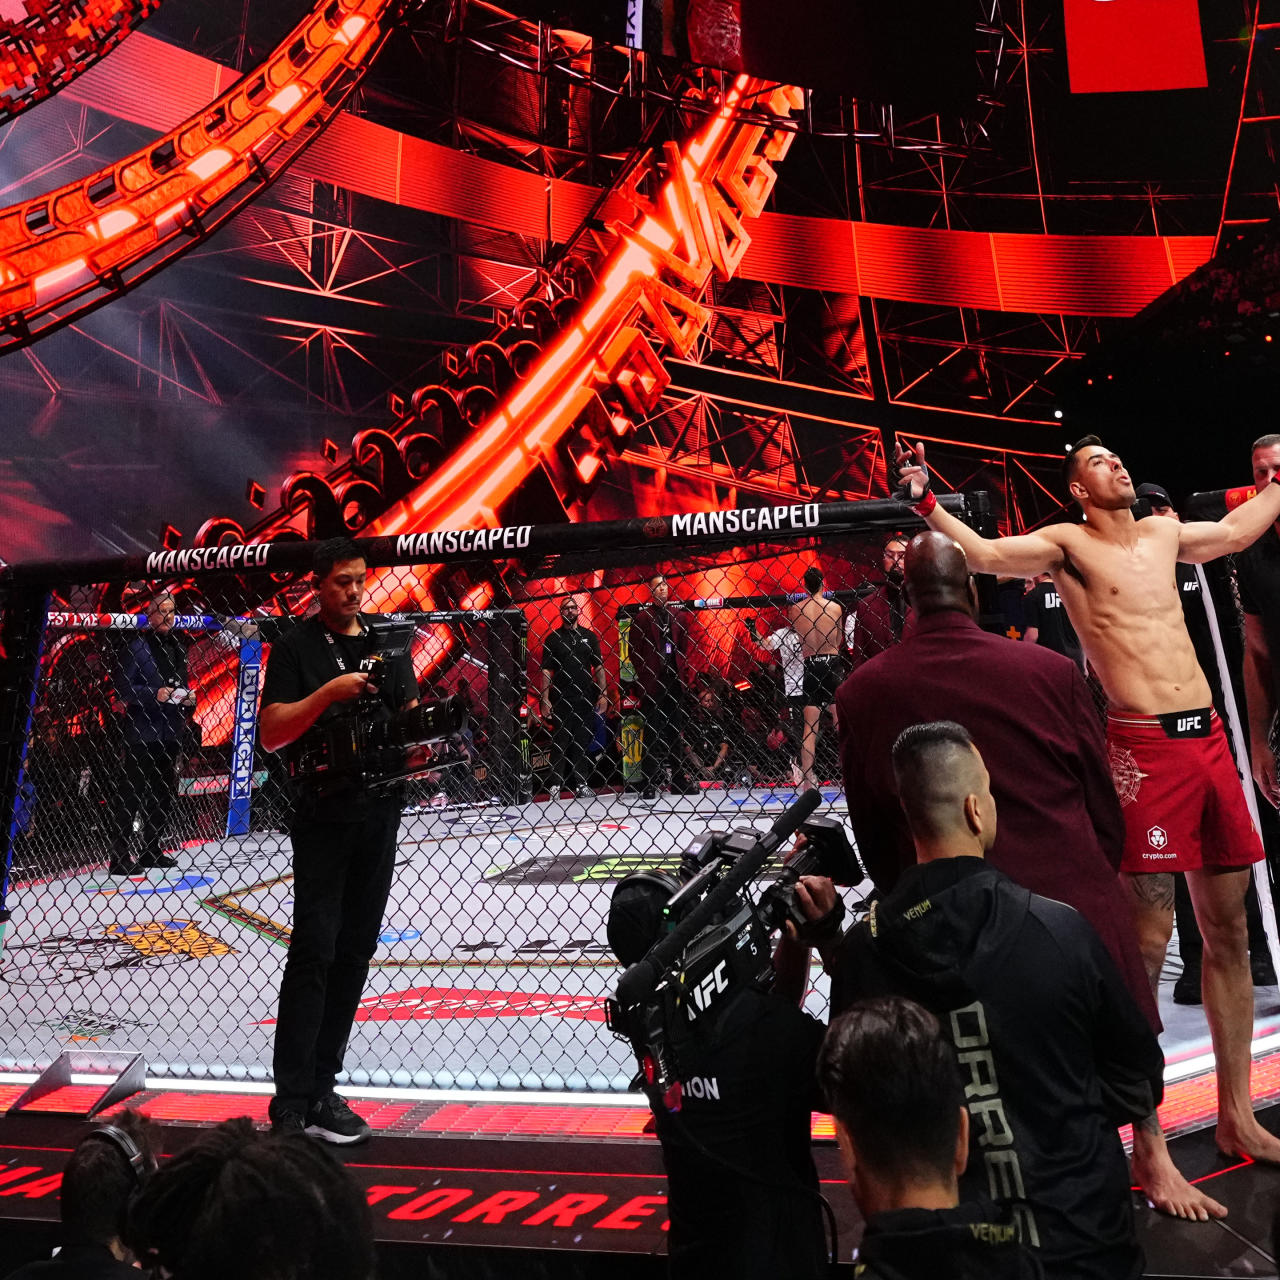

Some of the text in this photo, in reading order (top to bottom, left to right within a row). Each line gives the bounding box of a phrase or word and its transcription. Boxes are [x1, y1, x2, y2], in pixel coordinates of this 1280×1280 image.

[671, 503, 820, 537] MANSCAPED
[396, 526, 532, 557] MANSCAPED
[146, 543, 271, 574] MANSCAPED
[1183, 581, 1199, 592] UF
[1044, 592, 1062, 609] UF
[1177, 716, 1202, 732] UFC
[1142, 852, 1177, 860] crypto.com
[903, 899, 932, 921] VENUM
[750, 942, 758, 956] 5
[365, 1185, 670, 1231] TORRE
